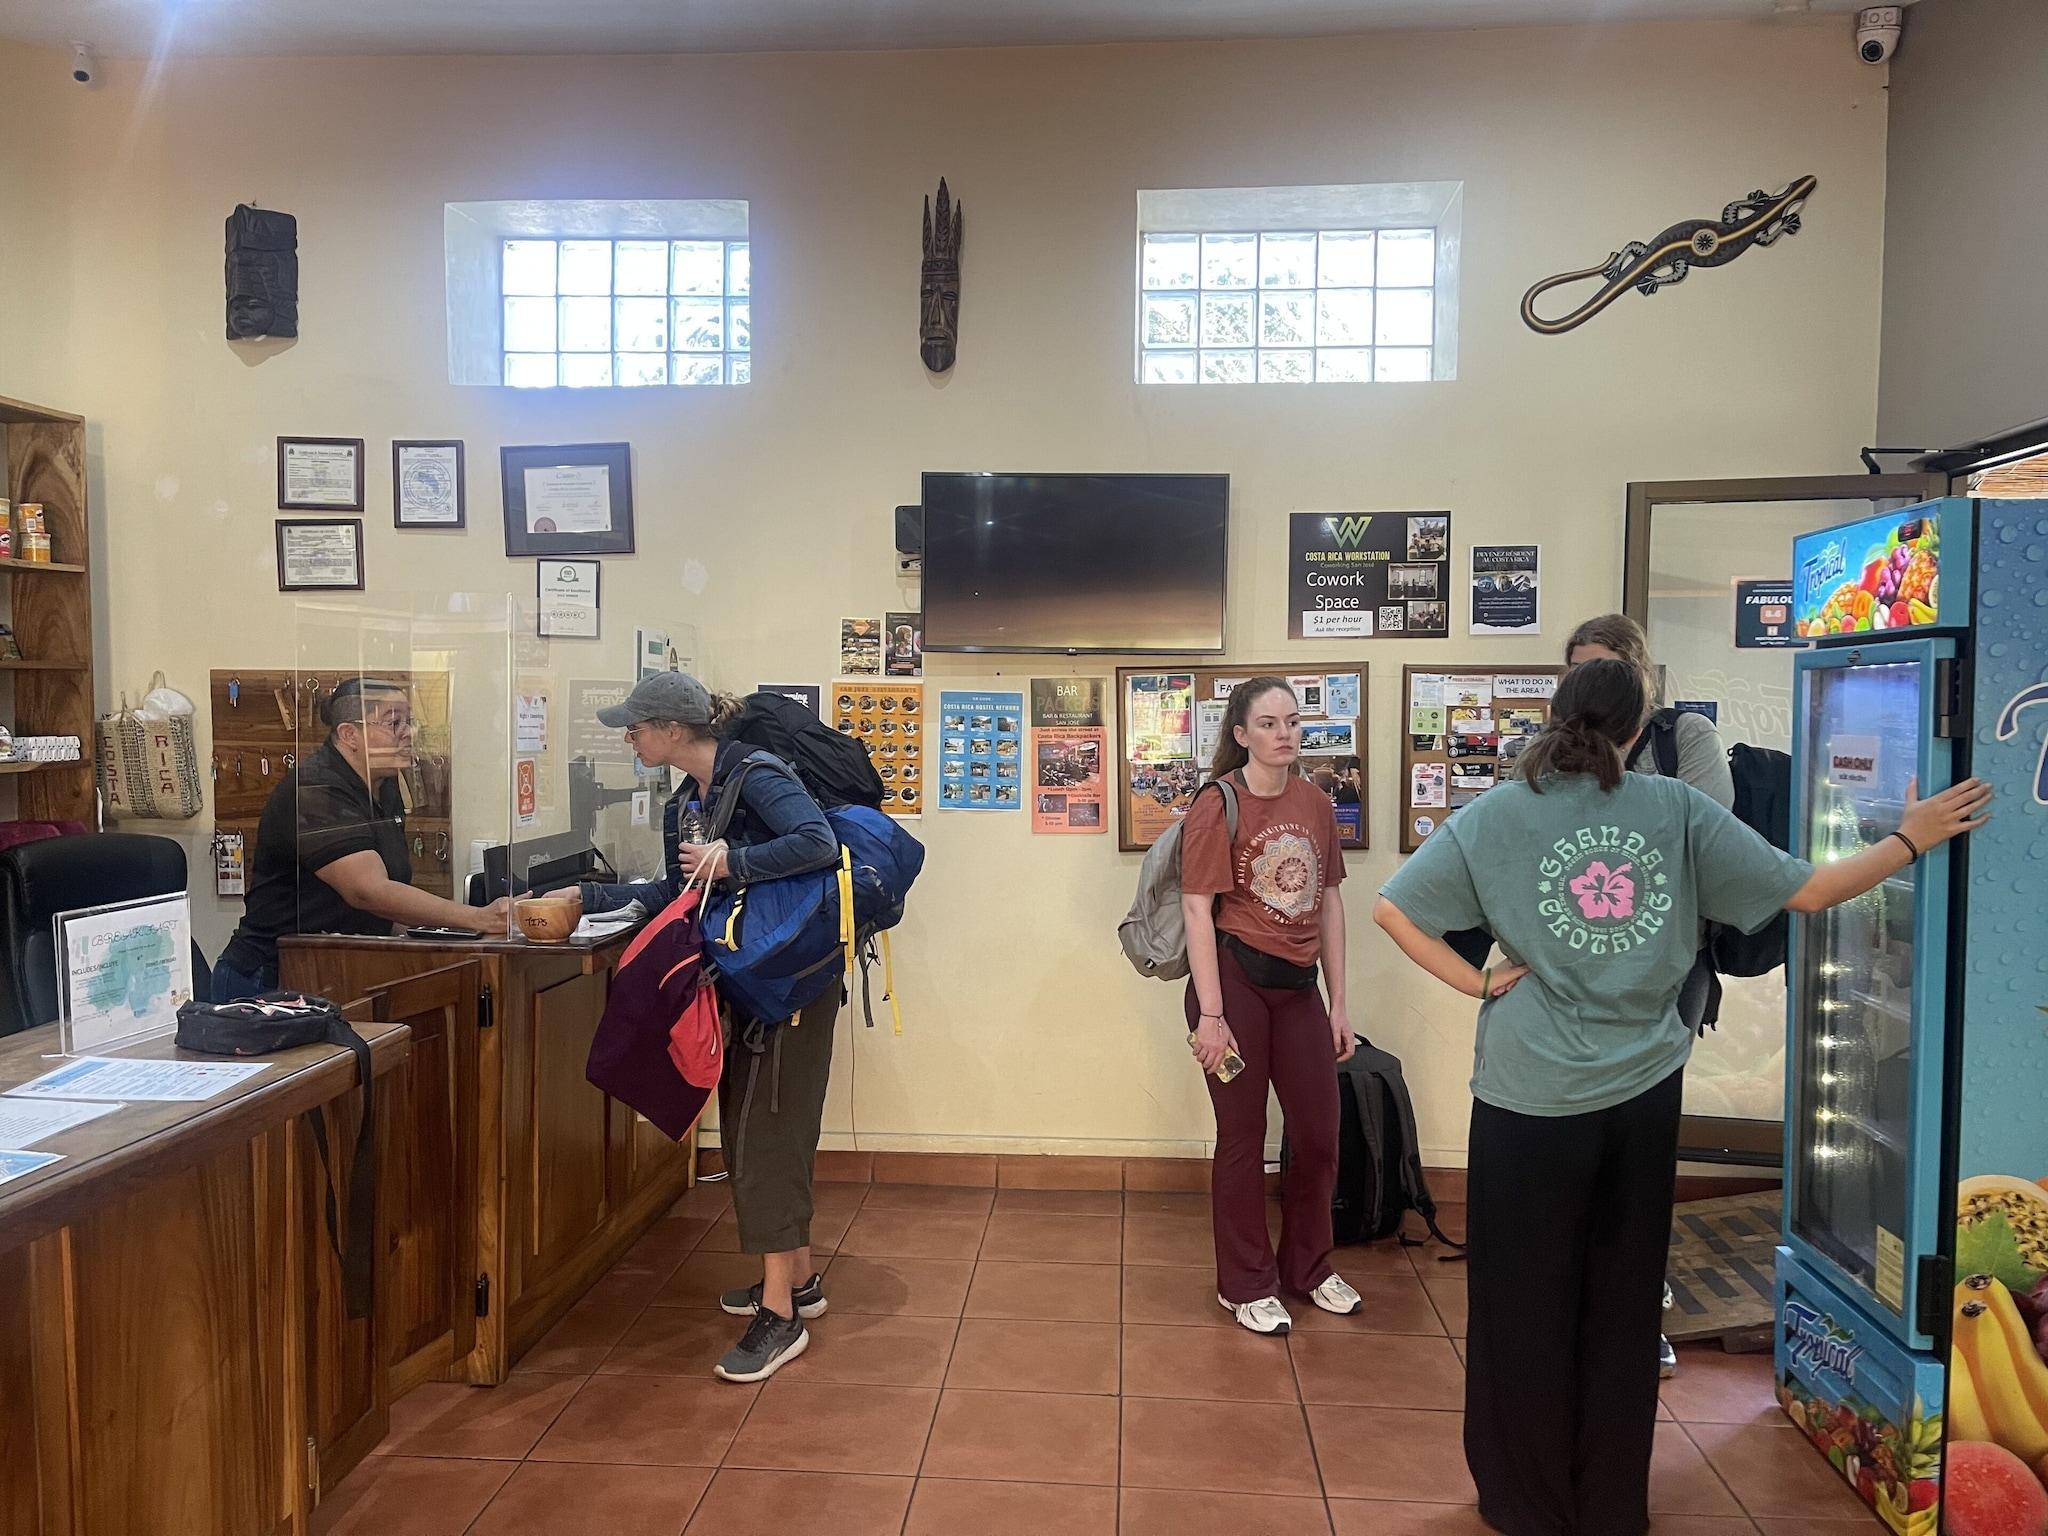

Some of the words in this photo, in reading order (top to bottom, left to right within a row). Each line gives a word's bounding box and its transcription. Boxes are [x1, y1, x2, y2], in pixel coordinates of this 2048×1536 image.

[1305, 552, 1326, 561] COSTA
[1328, 552, 1343, 561] RICA
[1344, 551, 1390, 561] WORKSTATION
[1802, 537, 1846, 602] Tropical
[1306, 571, 1365, 587] Cowork
[1315, 595, 1360, 612] Space
[1745, 596, 1793, 604] FABULOU
[1314, 616, 1323, 624] $1
[1326, 617, 1340, 625] per
[1056, 686, 1078, 696] BAR
[1220, 684, 1236, 693] FA
[103, 736, 121, 806] COSTA
[154, 736, 174, 794] RICA
[1834, 756, 1854, 768] CASH
[1854, 758, 1874, 771] ONLY
[1539, 826, 1664, 878] GHANDA
[526, 916, 548, 927] TIPS
[1538, 892, 1672, 955] CLOTHING
[92, 920, 178, 946] BREAKFAST
[1784, 1302, 1864, 1387] Tropical
